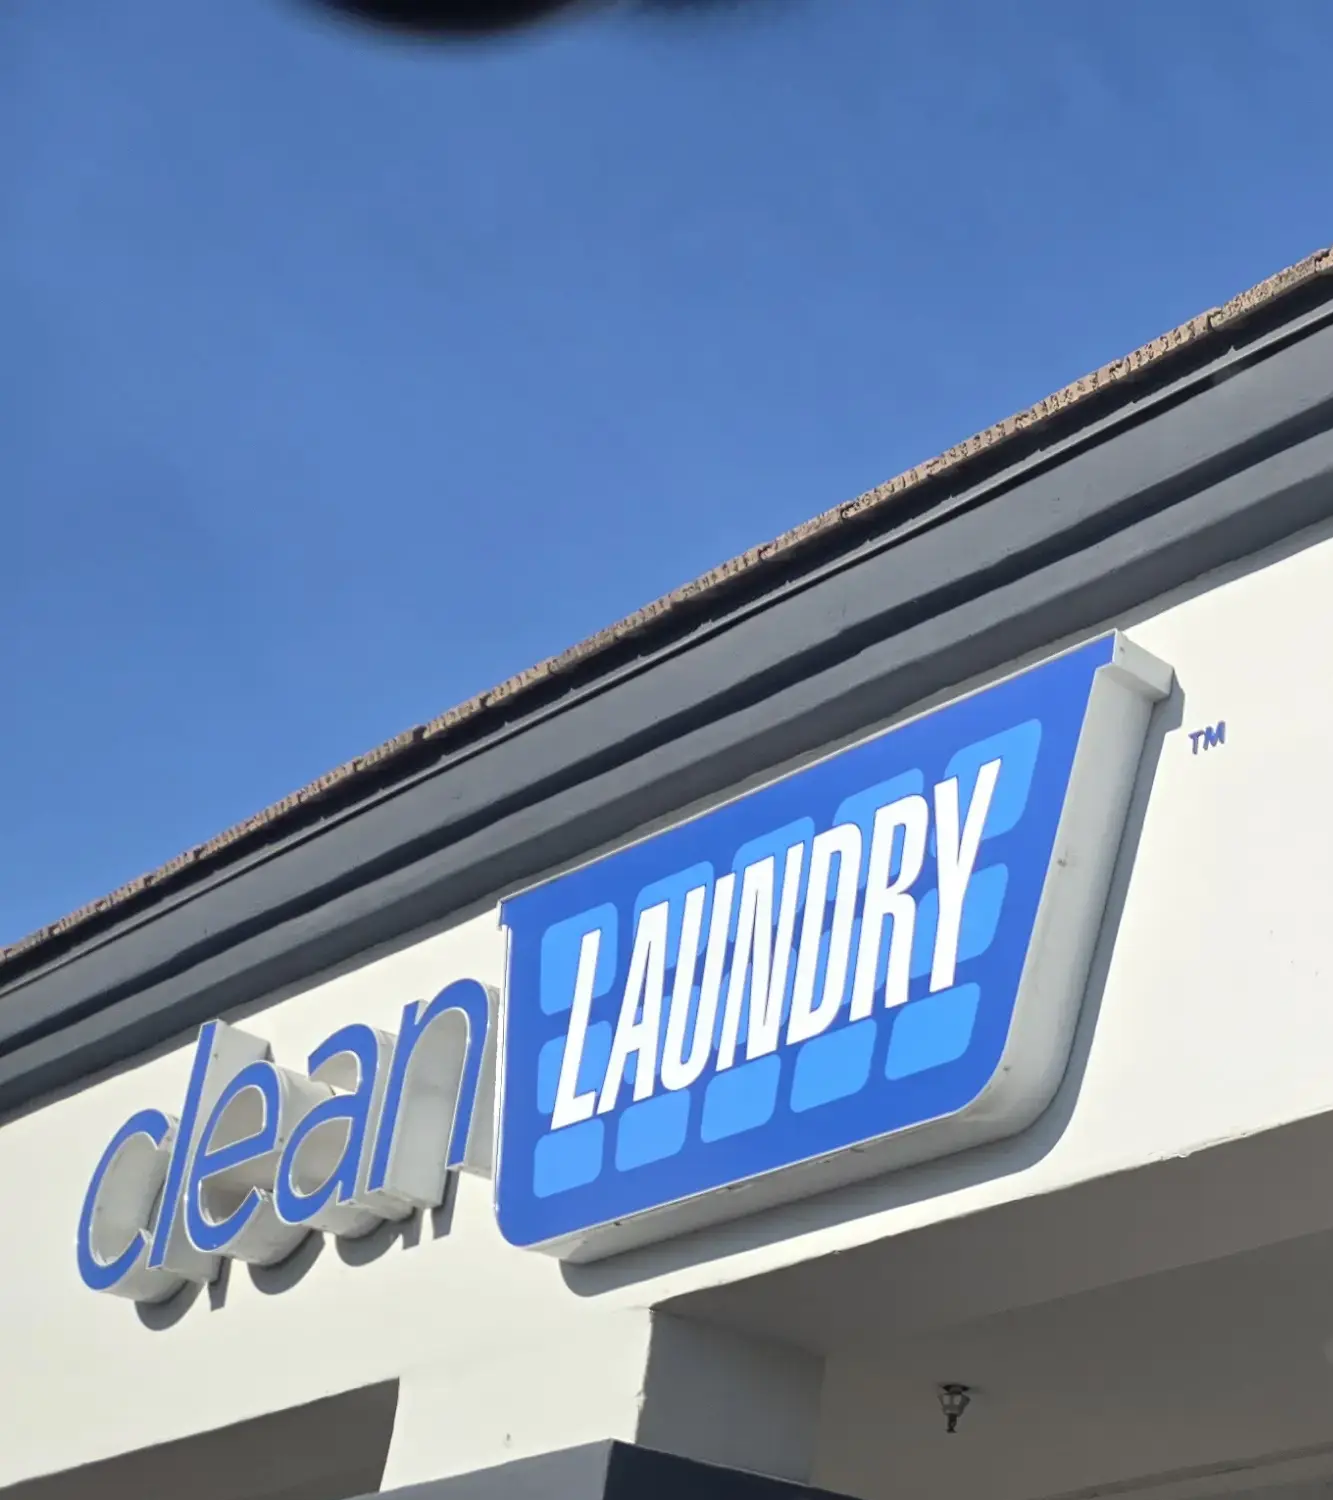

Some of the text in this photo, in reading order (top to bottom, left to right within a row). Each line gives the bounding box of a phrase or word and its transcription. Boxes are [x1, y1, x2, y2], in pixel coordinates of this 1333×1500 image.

[1188, 720, 1226, 755] TM
[551, 757, 1001, 1131] LAUNDRY
[76, 978, 490, 1291] clean
